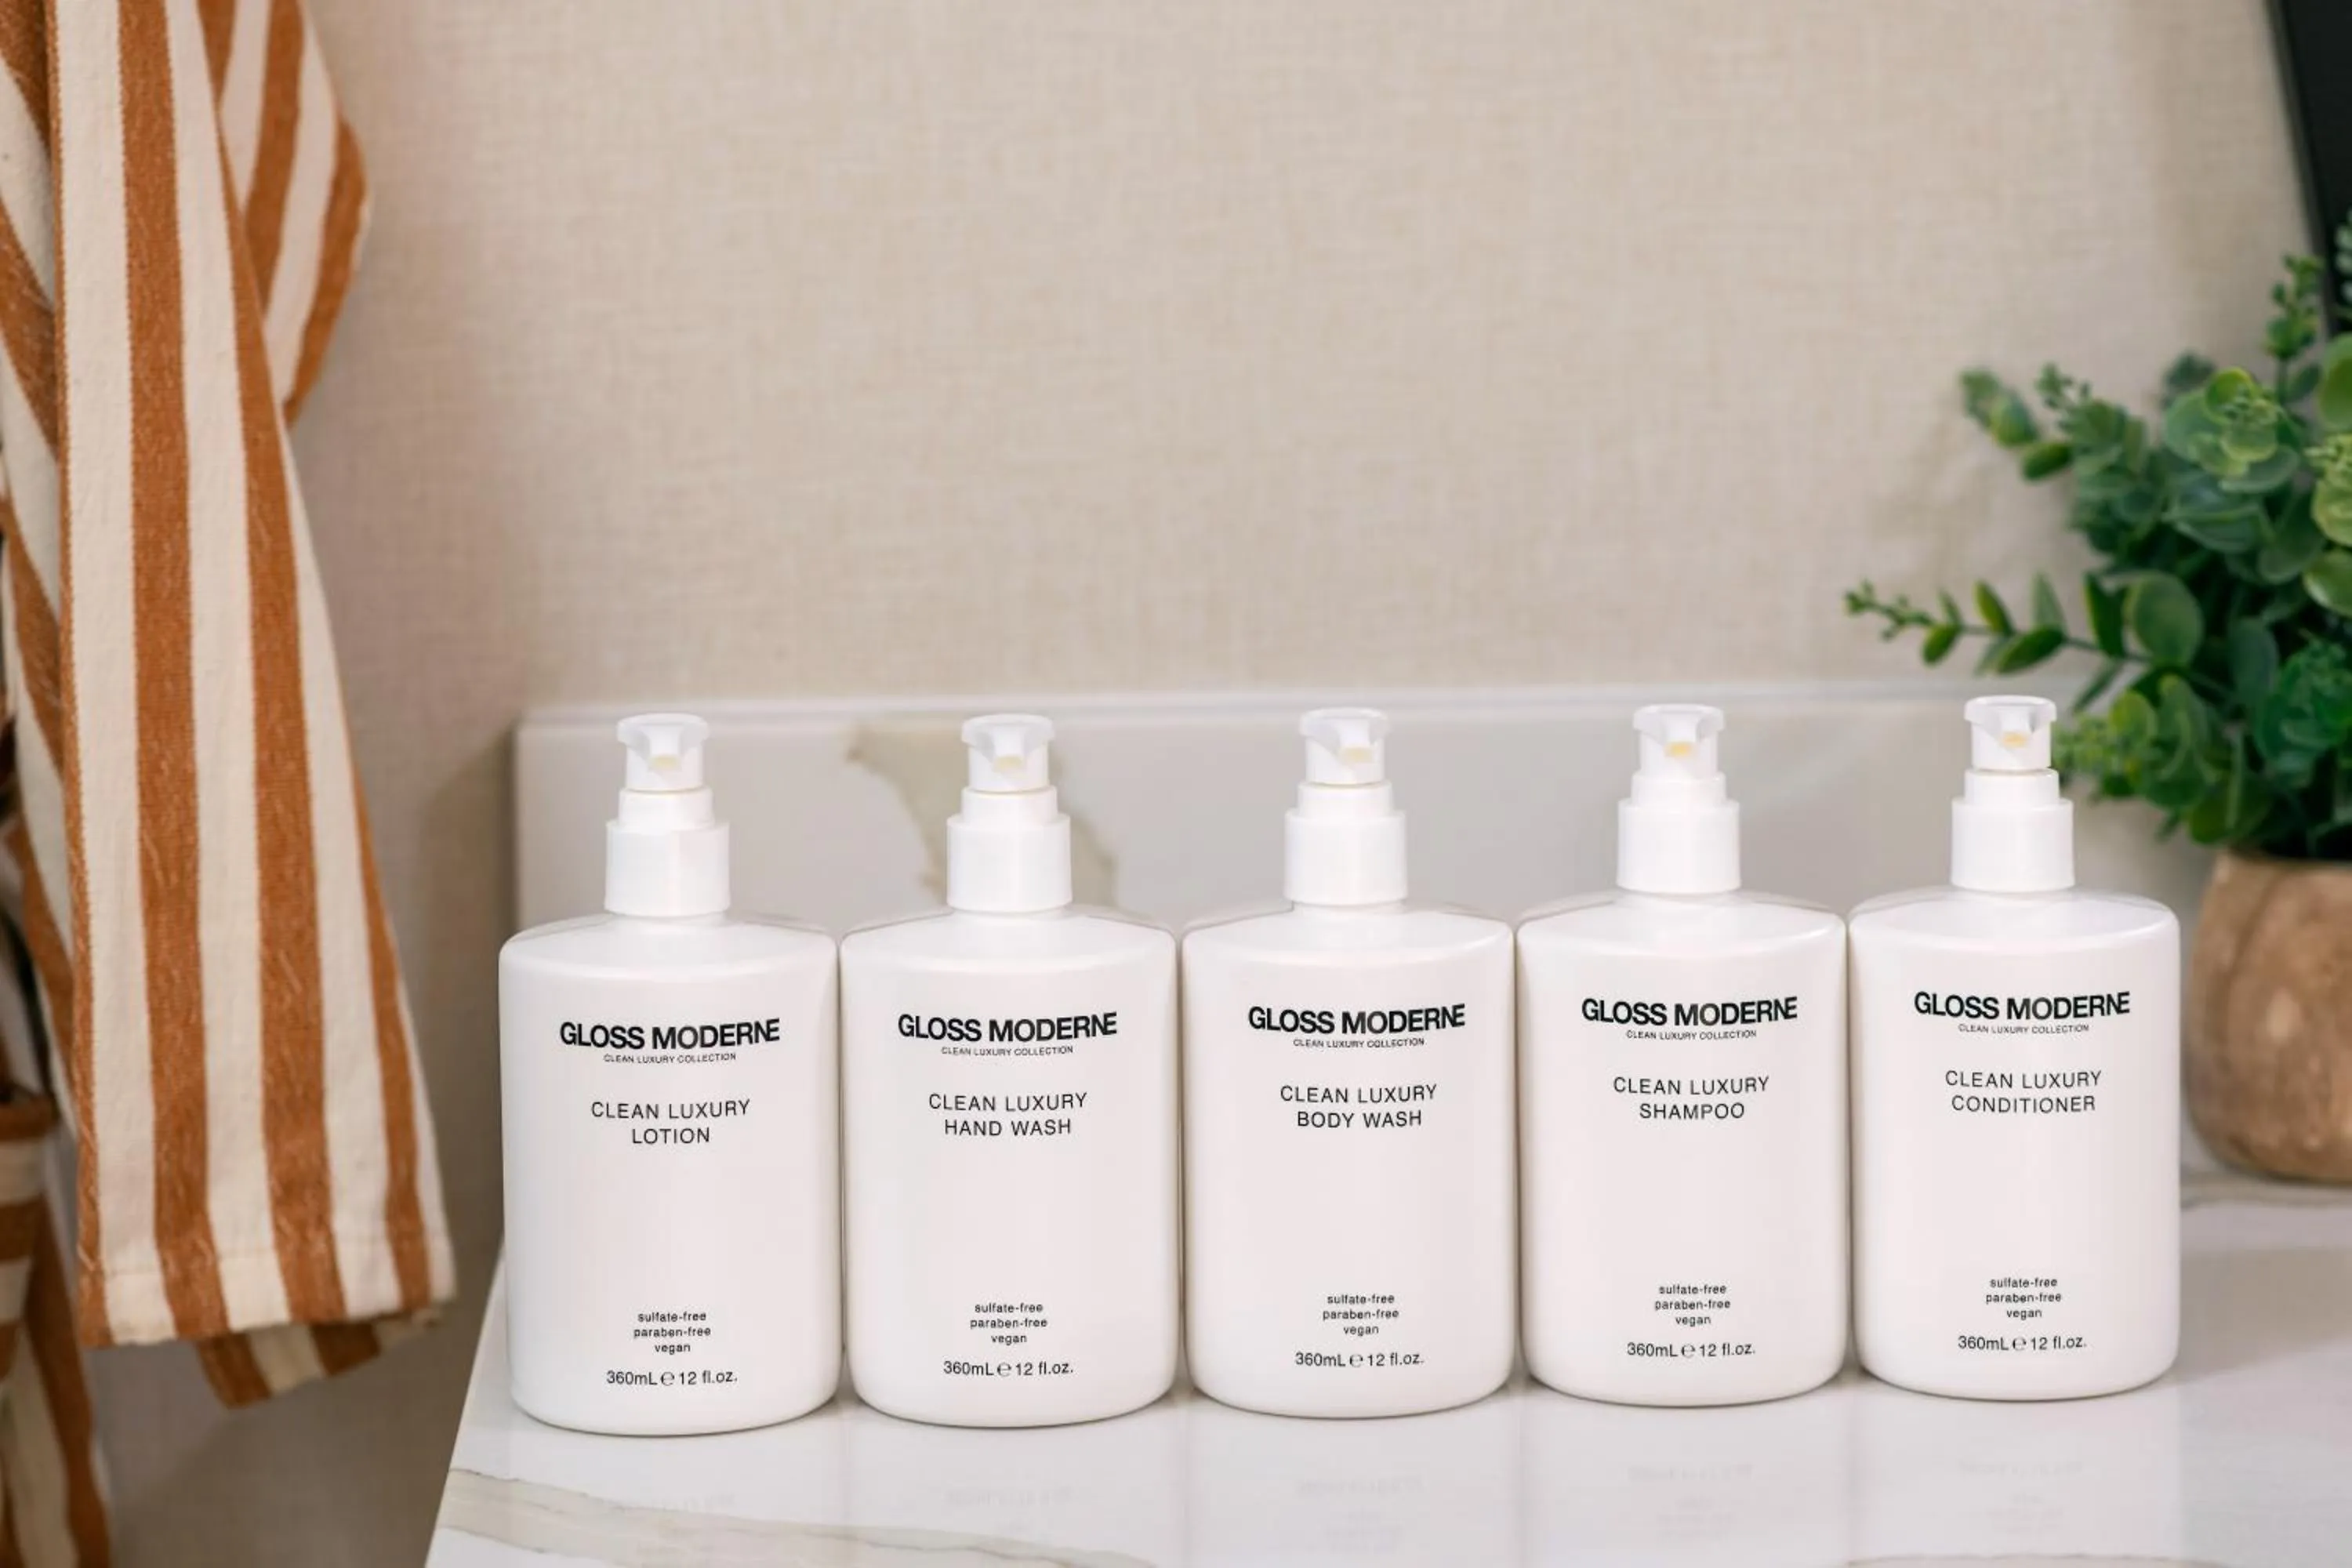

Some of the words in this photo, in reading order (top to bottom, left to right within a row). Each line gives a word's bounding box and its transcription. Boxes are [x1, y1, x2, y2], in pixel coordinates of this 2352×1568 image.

[1581, 996, 1668, 1026] GLOSS
[1674, 996, 1798, 1026] MODERNE
[1914, 991, 2000, 1020] GLOSS
[2006, 991, 2130, 1021] MODERNE
[1247, 1006, 1335, 1035] GLOSS
[1341, 1003, 1465, 1035] MODERNE
[898, 1014, 982, 1043] GLOSS
[989, 1011, 1117, 1043] MODERNE
[1958, 1024, 1988, 1033] CLEAN
[2031, 1024, 2089, 1034] COLLECTION
[560, 1022, 645, 1050] GLOSS
[652, 1018, 780, 1050] MODERNE
[1625, 1029, 1657, 1039] CLEAN
[1659, 1032, 1697, 1040] LUXURY
[1700, 1029, 1756, 1040] COLLECTION
[1293, 1039, 1324, 1047] CLEAN
[1367, 1038, 1425, 1048] COLLECTION
[941, 1047, 971, 1056] CLEAN
[1014, 1045, 1073, 1056] COLLECTION
[603, 1054, 634, 1063] CLEAN
[637, 1055, 675, 1064] LUXURY
[677, 1052, 736, 1064] COLLECTION
[1613, 1076, 1681, 1095] CLEAN
[1690, 1076, 1769, 1095] LUXURY
[1945, 1070, 2013, 1089] CLEAN
[2022, 1070, 2101, 1089] LUXURY
[1280, 1085, 1348, 1103] CLEAN
[1358, 1083, 1436, 1104] LUXURY
[929, 1092, 996, 1112] CLEAN
[1005, 1091, 1087, 1112] LUXURY
[1951, 1094, 2095, 1114] CONDITIONER
[591, 1102, 659, 1120] CLEAN
[669, 1098, 750, 1120] LUXURY
[1639, 1102, 1744, 1120] SHAMPOO
[1298, 1111, 1355, 1128] BODY
[1362, 1109, 1421, 1128] WASH
[945, 1120, 1002, 1137] HAND
[1011, 1118, 1071, 1137] WASH
[632, 1127, 710, 1145] LOTION
[1659, 1283, 1727, 1295] sulfate-free
[1990, 1277, 2057, 1288] sulfate-free
[1327, 1294, 1395, 1305] sulfate-free
[1654, 1299, 1731, 1311] paraben-free
[1986, 1292, 2061, 1305] paraben-free
[975, 1302, 1044, 1313] sulfate-free
[637, 1311, 706, 1323] sulfate-free
[1323, 1308, 1399, 1321] paraben-free
[2006, 1309, 2042, 1321] vegan
[970, 1318, 1047, 1330] paraben-free
[1675, 1316, 1711, 1327] vegan
[633, 1327, 711, 1339] paraben-free
[1344, 1326, 1379, 1337] vegan
[991, 1335, 1027, 1346] vegan
[2031, 1337, 2048, 1351] 12
[654, 1344, 691, 1355] vegan
[1700, 1343, 1717, 1357] 12
[1367, 1352, 1385, 1367] 12
[1015, 1362, 1033, 1376] 12
[679, 1371, 697, 1385] 12
